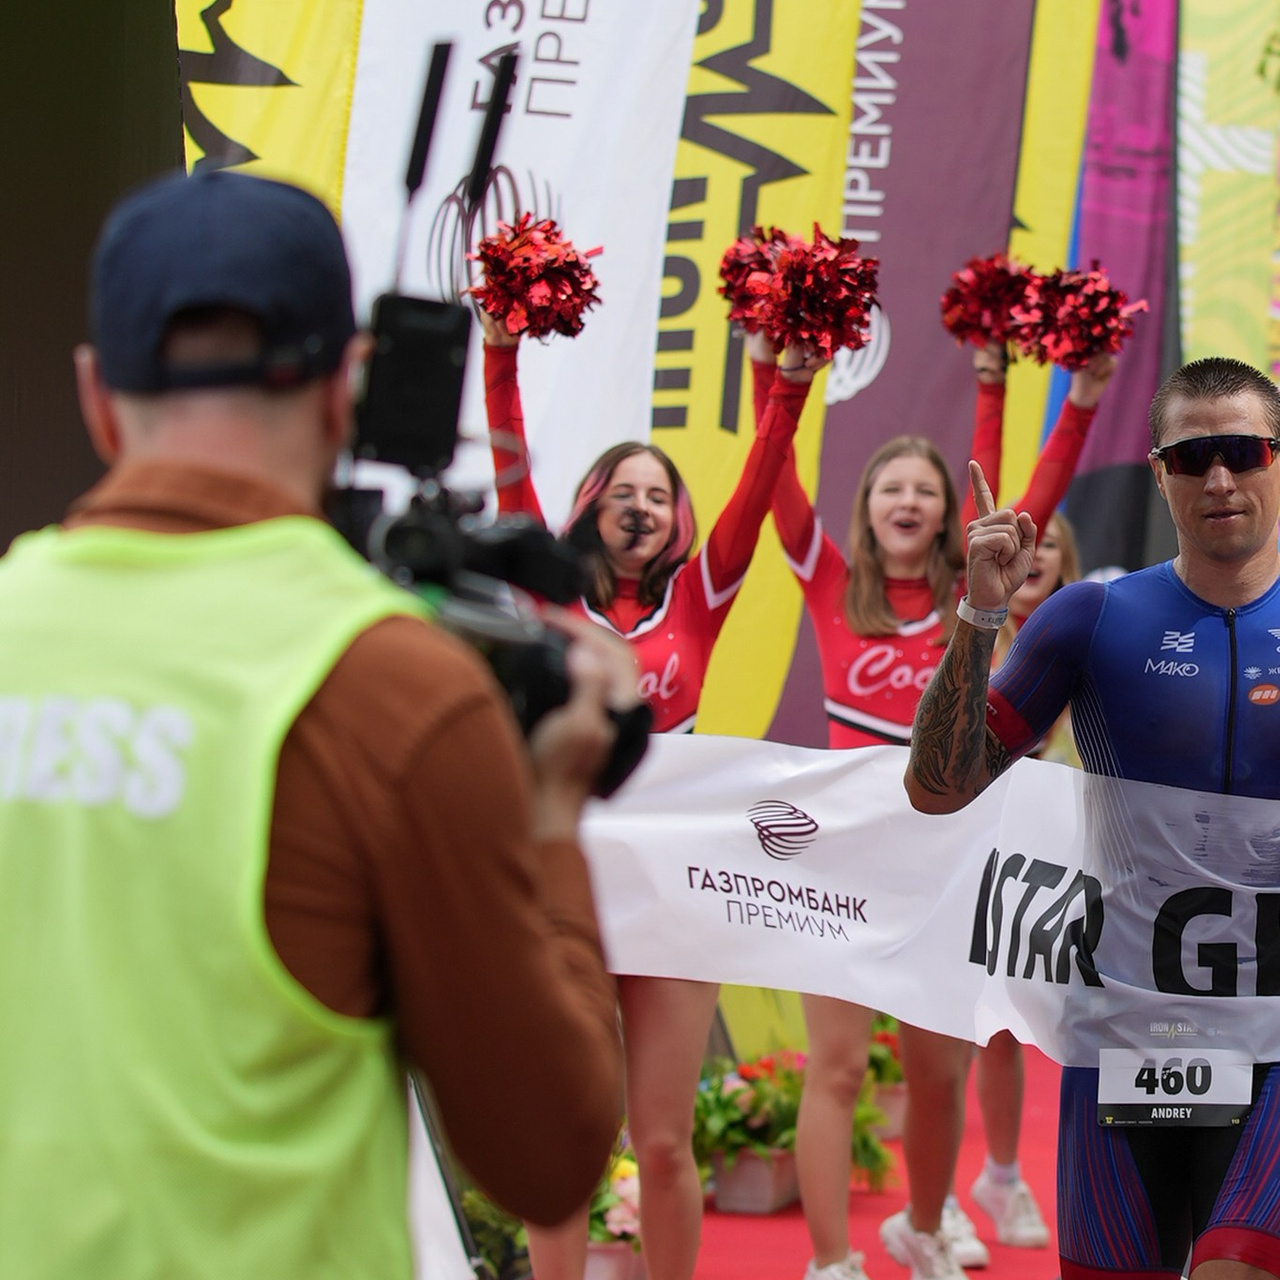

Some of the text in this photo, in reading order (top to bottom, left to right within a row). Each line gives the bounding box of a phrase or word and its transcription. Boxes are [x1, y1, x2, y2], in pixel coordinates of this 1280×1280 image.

[846, 644, 938, 697] Coo
[687, 865, 868, 924] ГАЗПРОМБАНК
[726, 900, 850, 943] ПРЕМИУМ
[1134, 1058, 1213, 1097] 460
[1151, 1107, 1193, 1119] ANDREY
